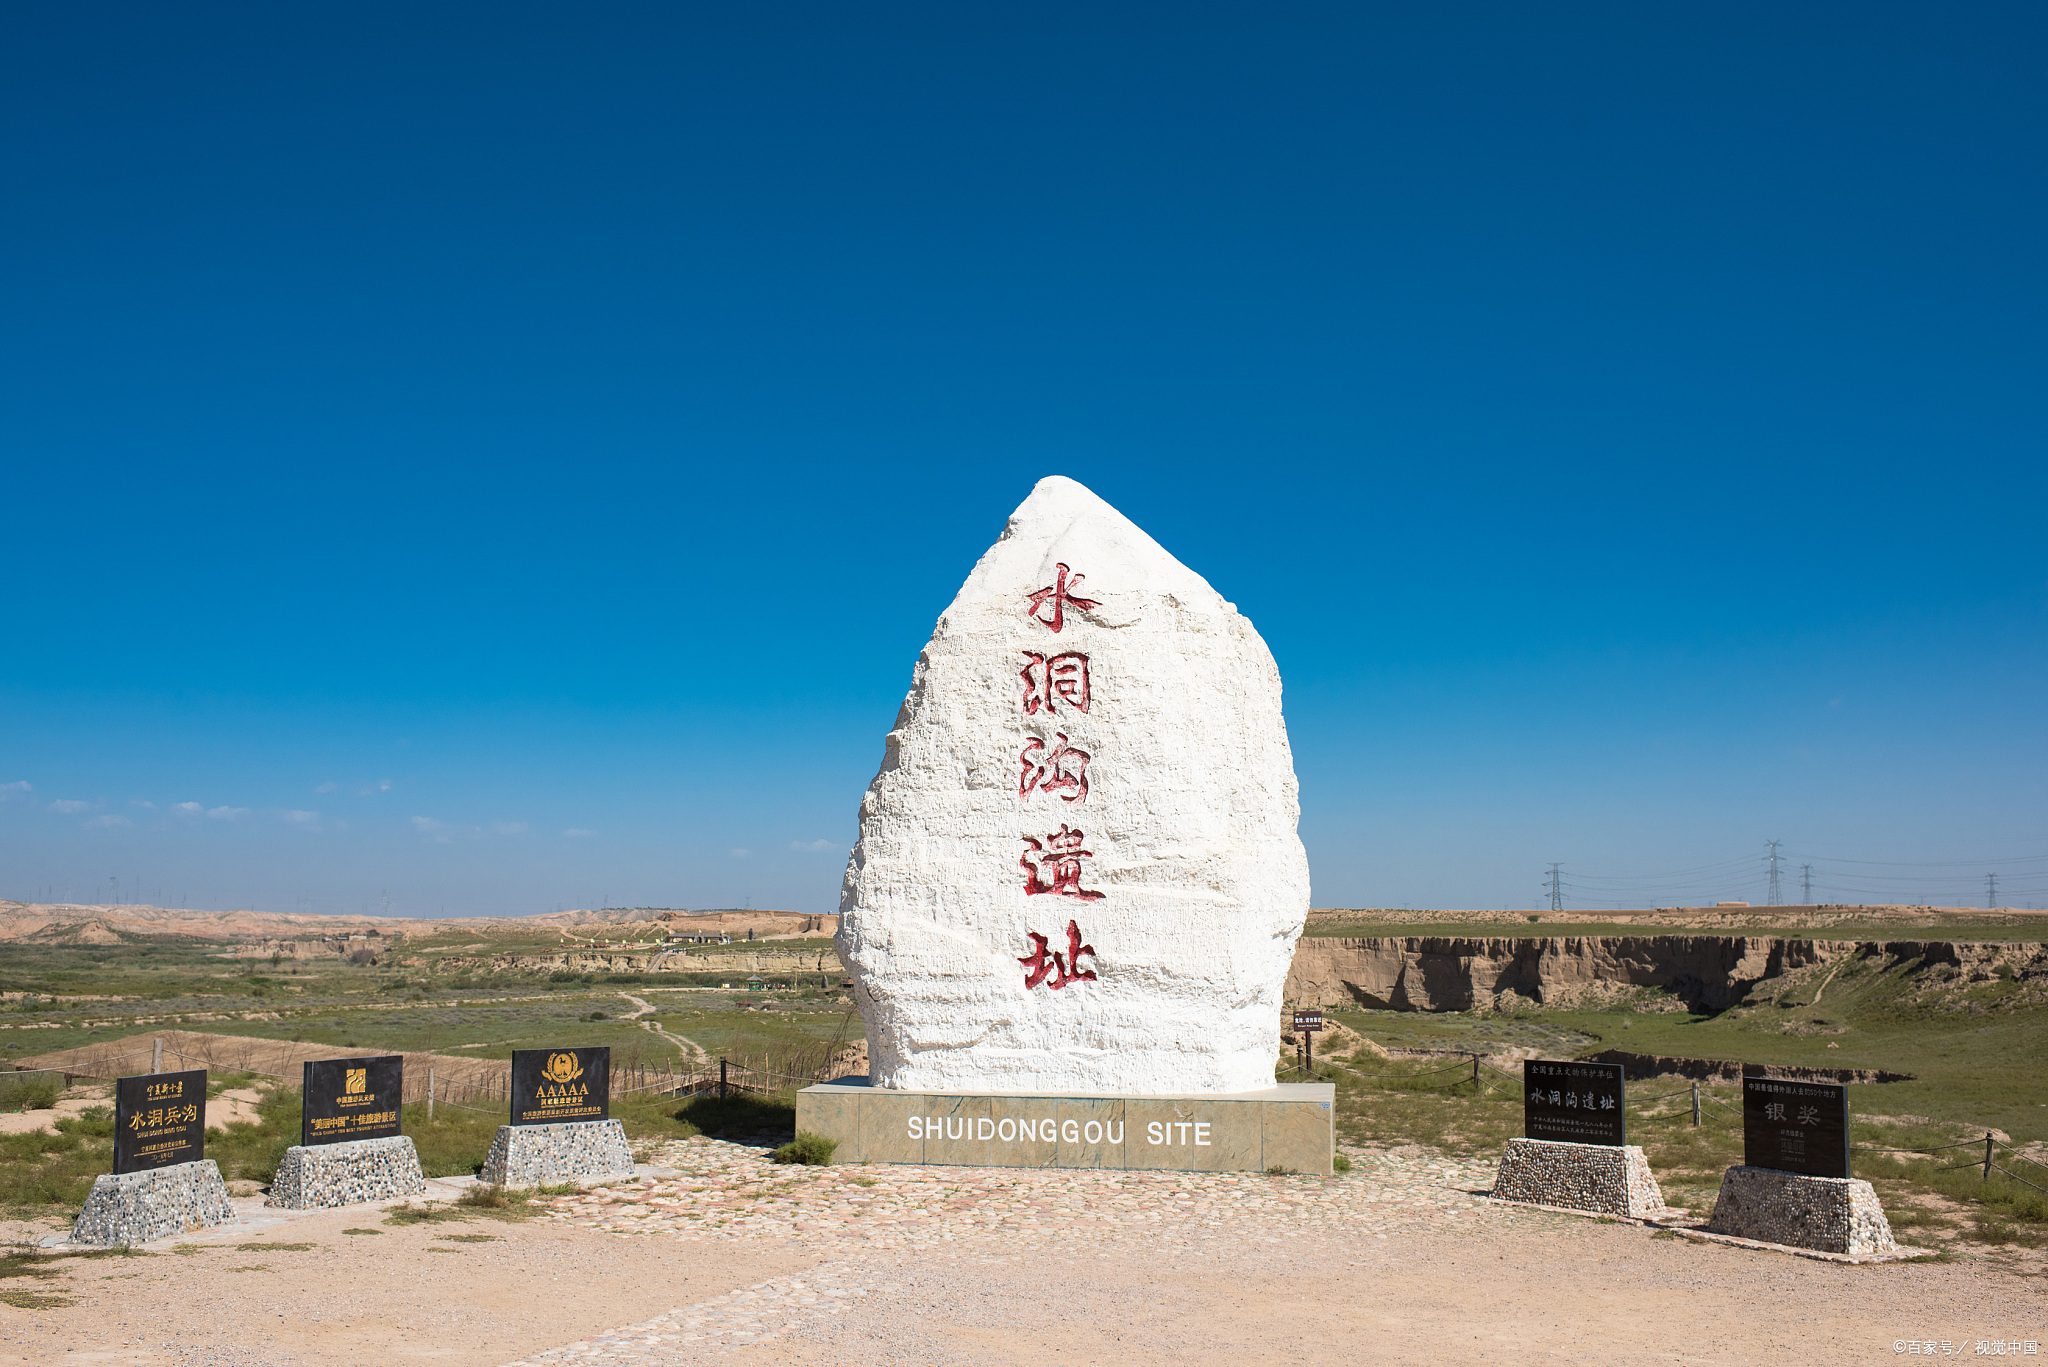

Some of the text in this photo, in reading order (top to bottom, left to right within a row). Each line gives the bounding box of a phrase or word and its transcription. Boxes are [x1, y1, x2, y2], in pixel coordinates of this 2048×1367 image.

[1017, 562, 1106, 990] 水洞沟遗址
[1531, 1065, 1614, 1079] 全国重点文物保护单位
[535, 1082, 589, 1098] AAAAA
[1530, 1087, 1615, 1110] 水洞沟遗址
[1748, 1082, 1836, 1099] 中国最值得外国人去的50个地方
[129, 1104, 197, 1130] 水洞兵沟
[1764, 1101, 1820, 1126] 银奖
[907, 1115, 1212, 1146] SHUIDONGGOU SITE
